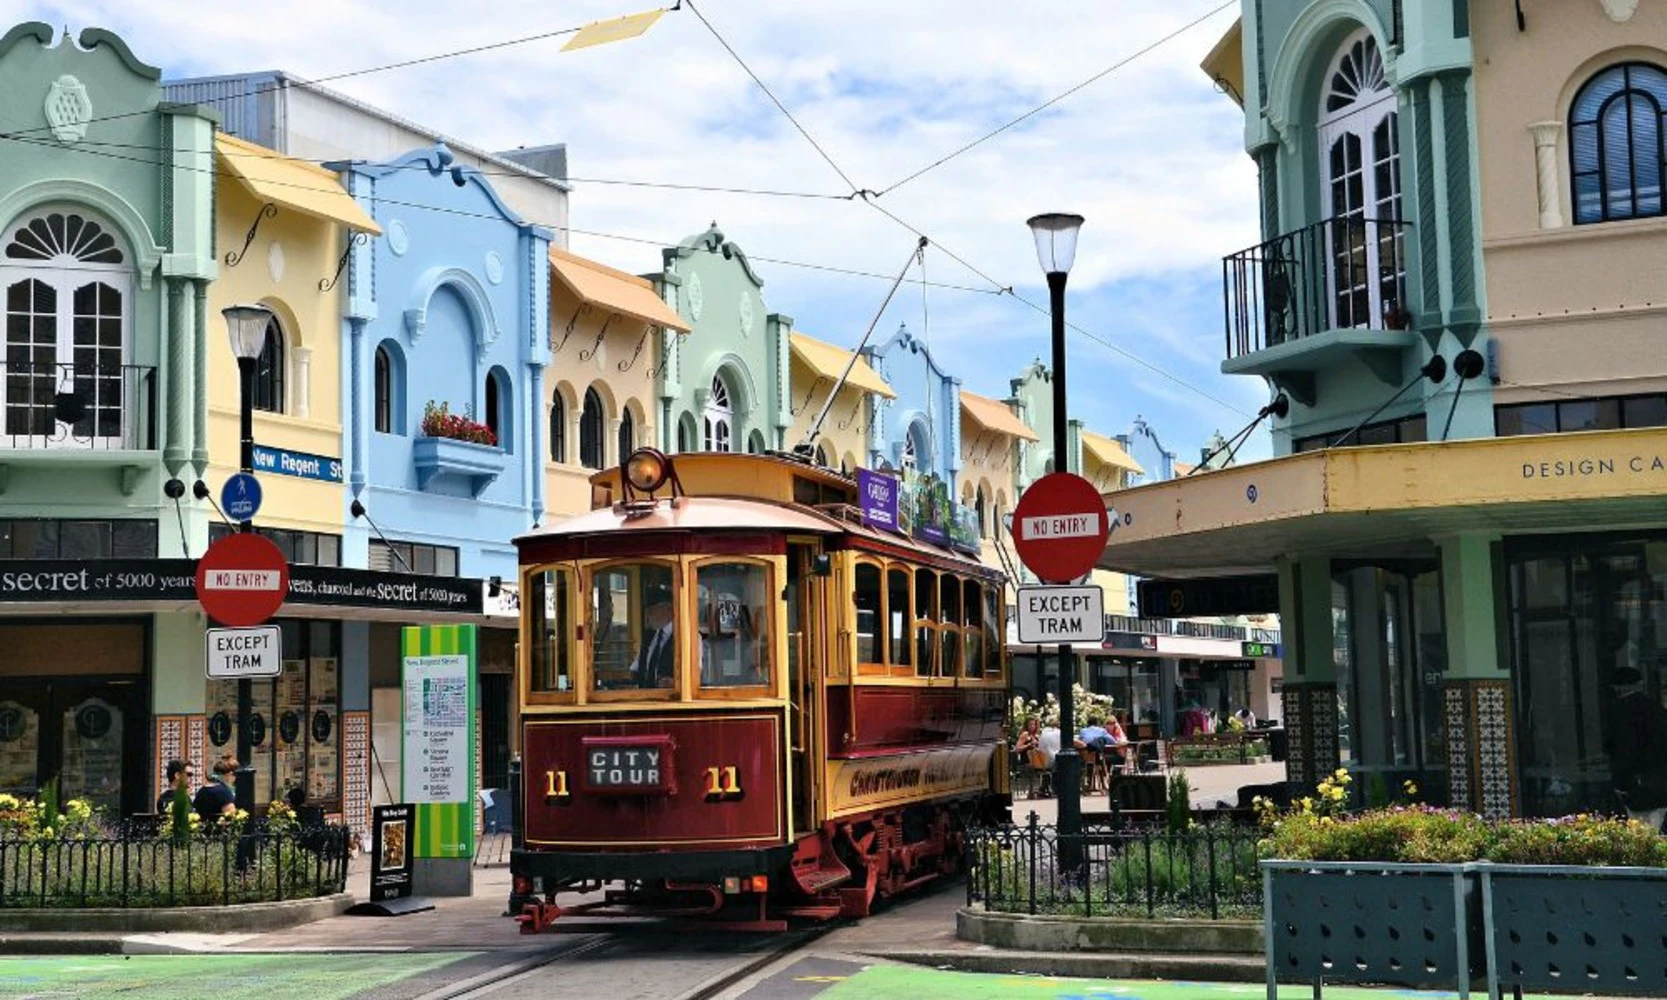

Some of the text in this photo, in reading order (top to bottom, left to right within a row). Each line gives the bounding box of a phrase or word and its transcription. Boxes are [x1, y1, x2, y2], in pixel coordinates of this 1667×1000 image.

[281, 453, 320, 475] Regent
[329, 461, 343, 478] St
[1522, 460, 1615, 479] DESIGN
[1033, 518, 1088, 535] NO ENTRY
[2, 568, 90, 591] secret
[95, 573, 113, 588] of
[116, 573, 155, 588] 5000
[216, 573, 270, 586] NO ENTRY
[377, 582, 418, 602] secret
[429, 588, 447, 601] 5000
[1029, 596, 1091, 613] EXCEPT
[1038, 617, 1083, 634] TRAM
[217, 635, 269, 651] EXCEPT
[225, 655, 262, 669] TRAM
[591, 751, 660, 766] CITY
[546, 771, 570, 796] 11
[592, 769, 660, 784] TOUR
[707, 766, 741, 793] 11
